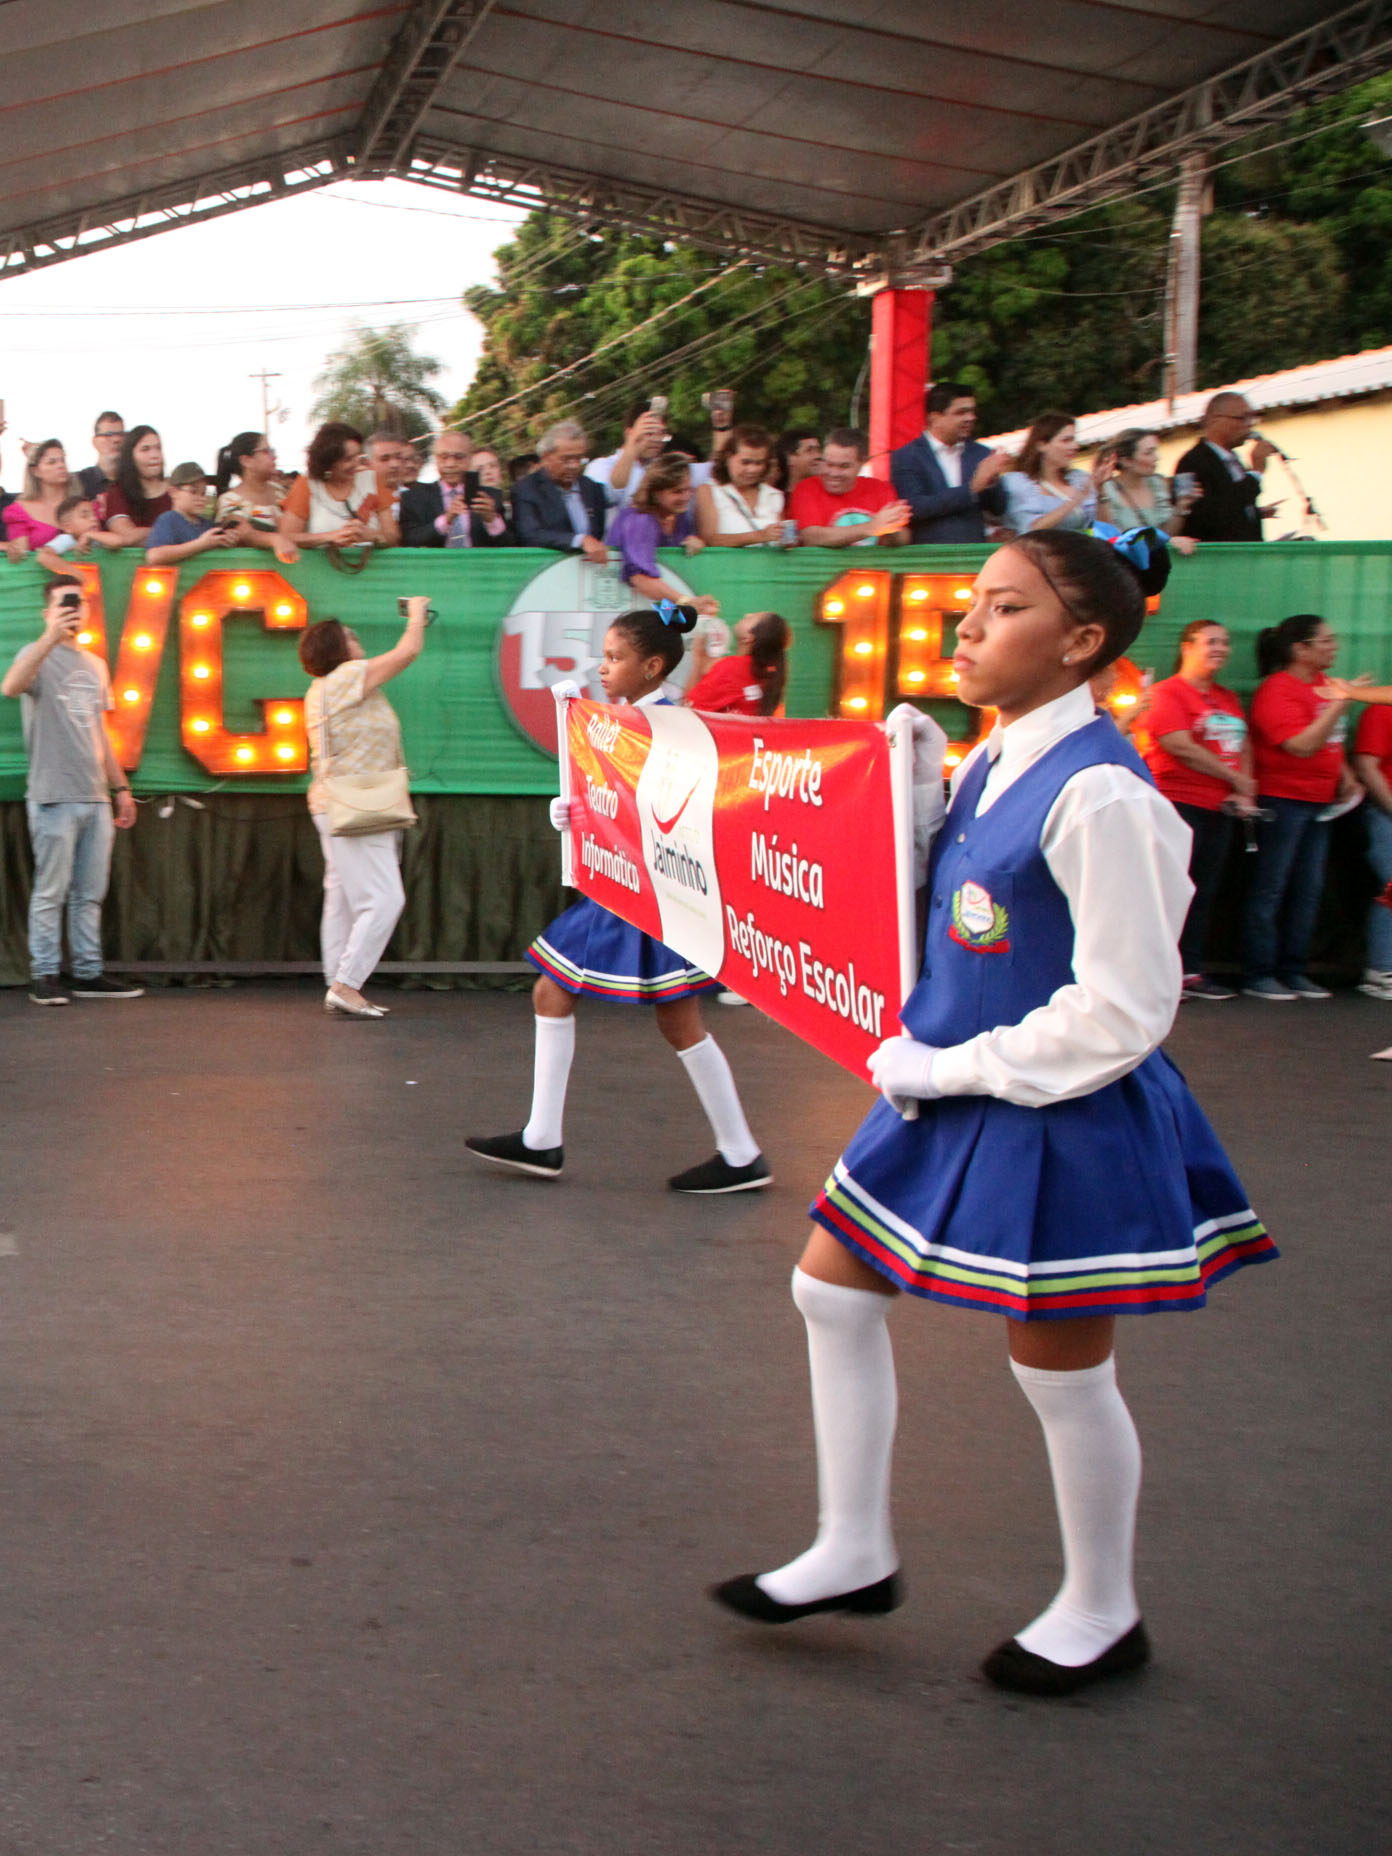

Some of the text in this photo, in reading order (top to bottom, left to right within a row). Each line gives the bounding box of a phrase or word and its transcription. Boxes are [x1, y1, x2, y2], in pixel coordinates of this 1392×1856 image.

[585, 775, 618, 820] Teatro
[748, 738, 823, 811] Esporte
[581, 832, 640, 894] Informática
[651, 828, 708, 897] Jaiminho
[750, 831, 825, 909] Música
[725, 903, 886, 1039] Reforço Escolar
